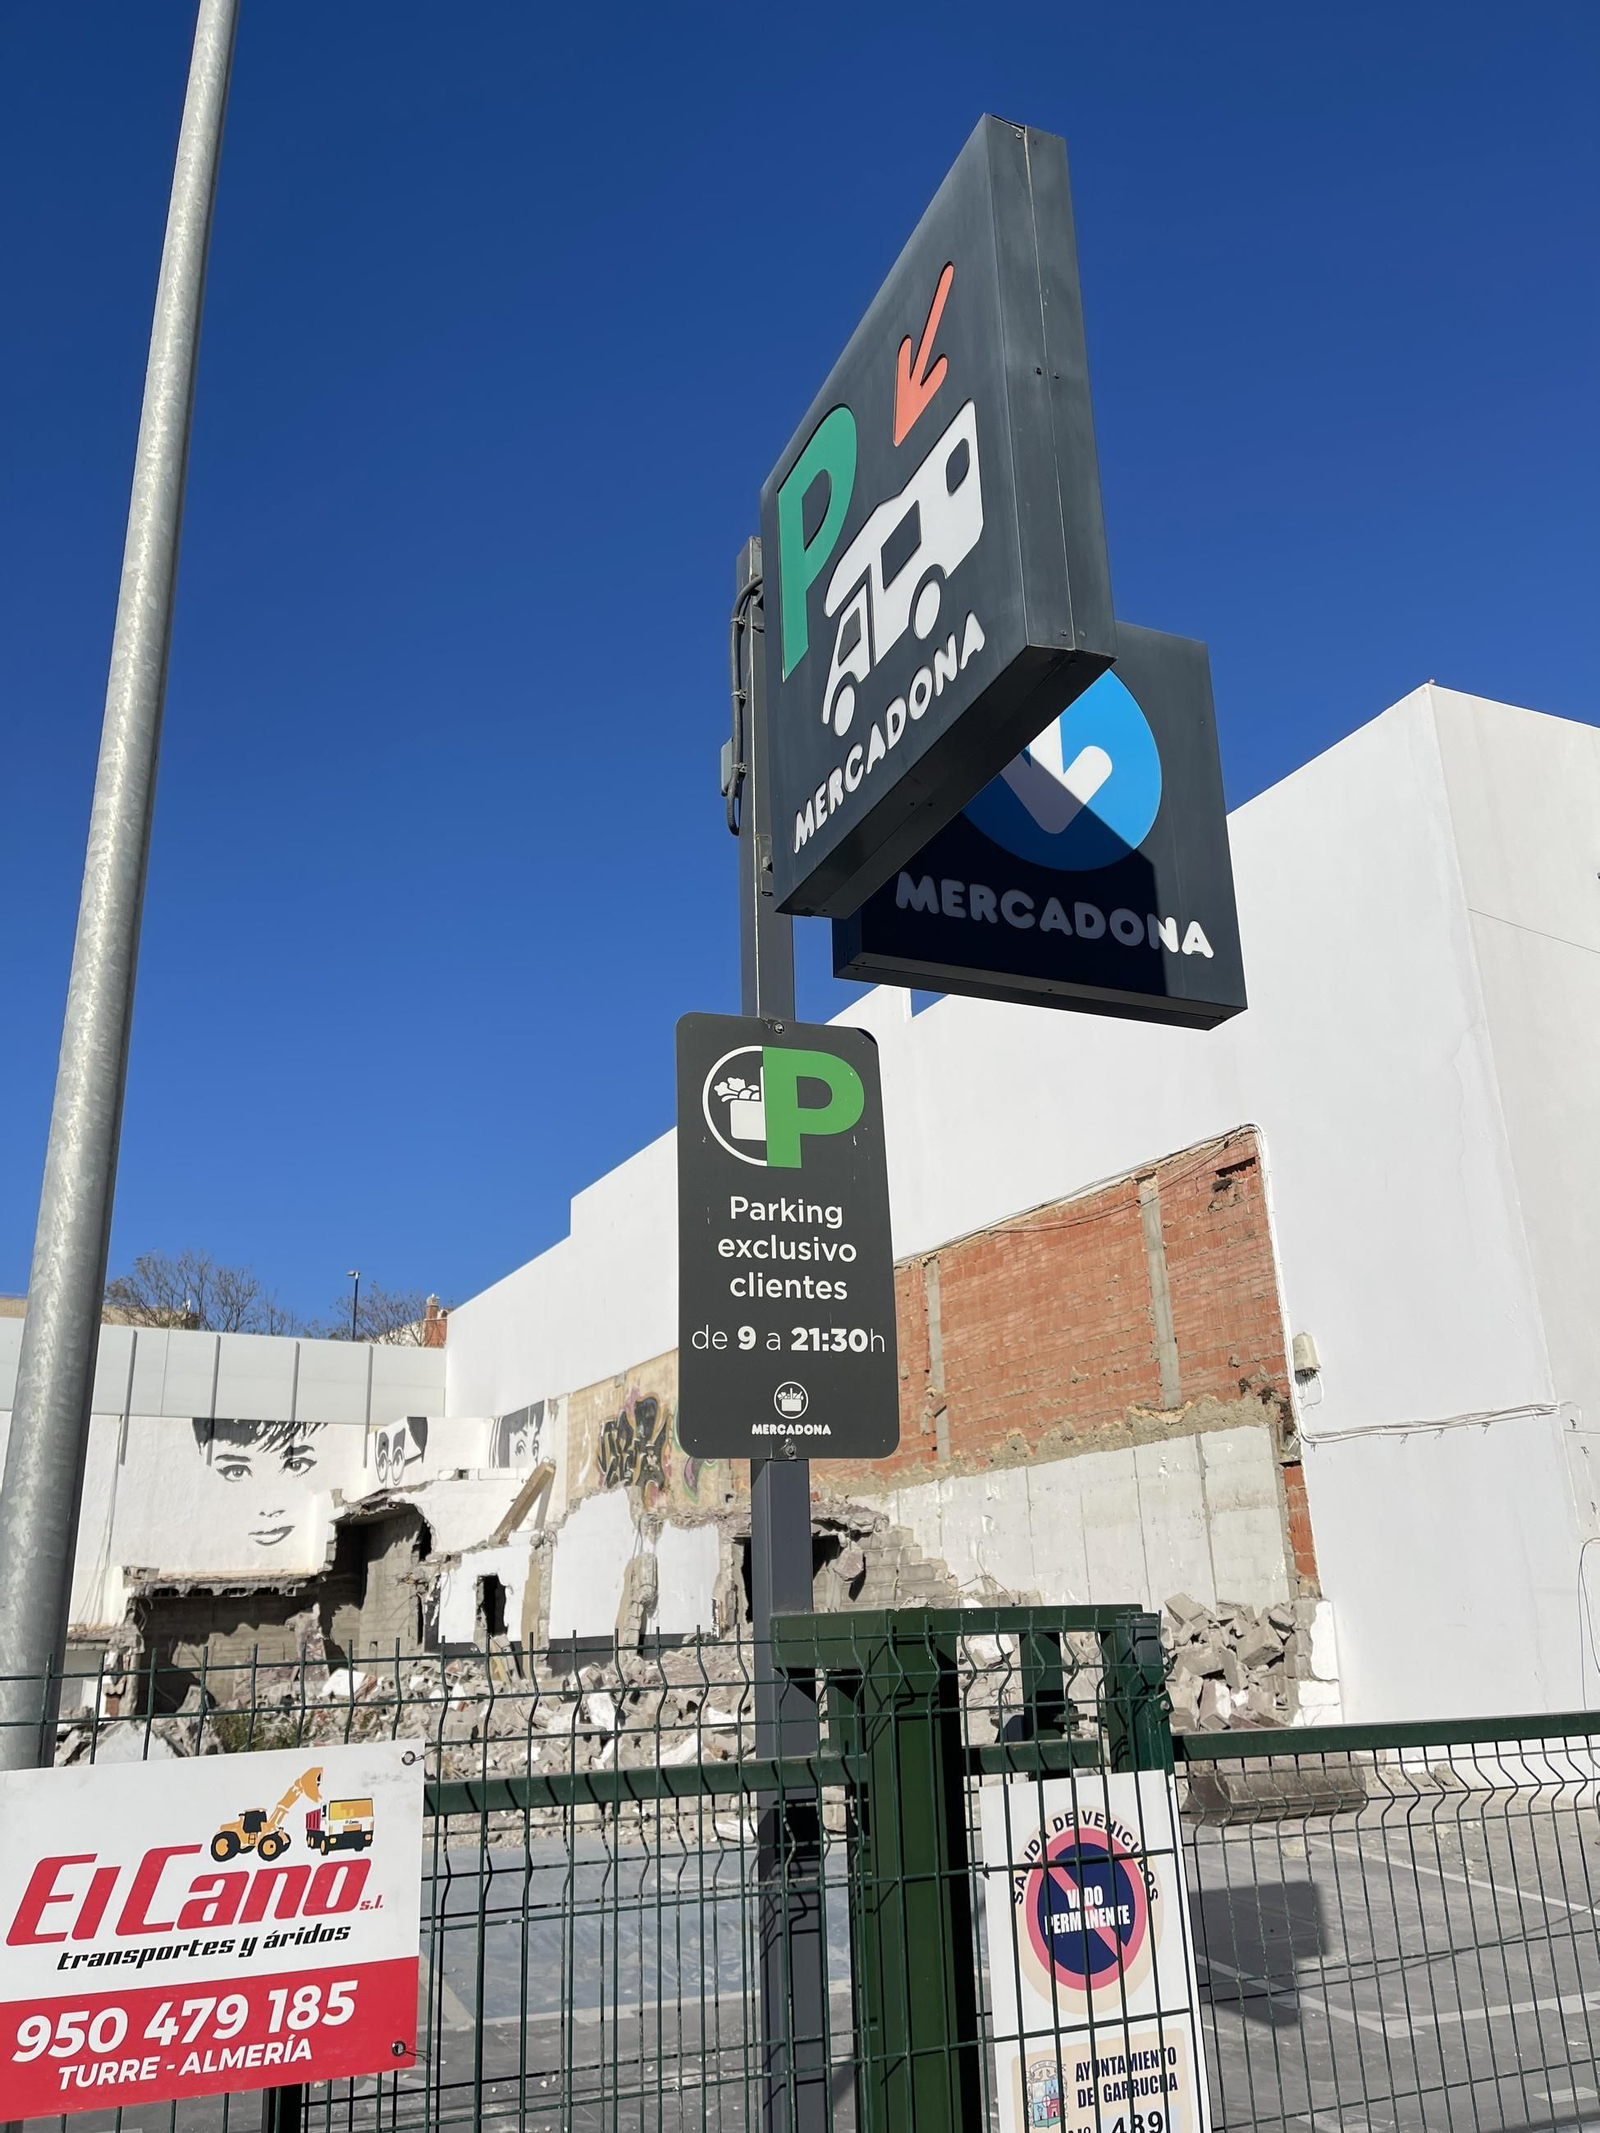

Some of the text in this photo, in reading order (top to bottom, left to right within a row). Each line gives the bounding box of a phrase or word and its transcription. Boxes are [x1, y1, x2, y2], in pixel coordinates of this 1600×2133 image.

[777, 404, 857, 682] P
[793, 610, 987, 853] MERCADONA
[895, 871, 1215, 959] MERCADONA
[762, 1045, 865, 1169] P
[730, 1195, 843, 1228] Parking
[717, 1234, 857, 1263] exclusivo
[729, 1272, 848, 1300] clientes
[691, 1325, 886, 1353] de 9 a 21:30h
[751, 1423, 832, 1436] MERCADONA
[1013, 1830, 1051, 1905] SAID
[1052, 1812, 1076, 1833] DE
[115, 1843, 372, 1937] Cano
[57, 1922, 352, 1970] transportes y áridos
[11, 1979, 359, 2063] 950 479 185
[58, 2058, 159, 2091] TURRE
[179, 2036, 313, 2077] ALMERÍA
[1075, 2046, 1177, 2083] AYNTAMIENO
[1077, 2086, 1096, 2109] DE
